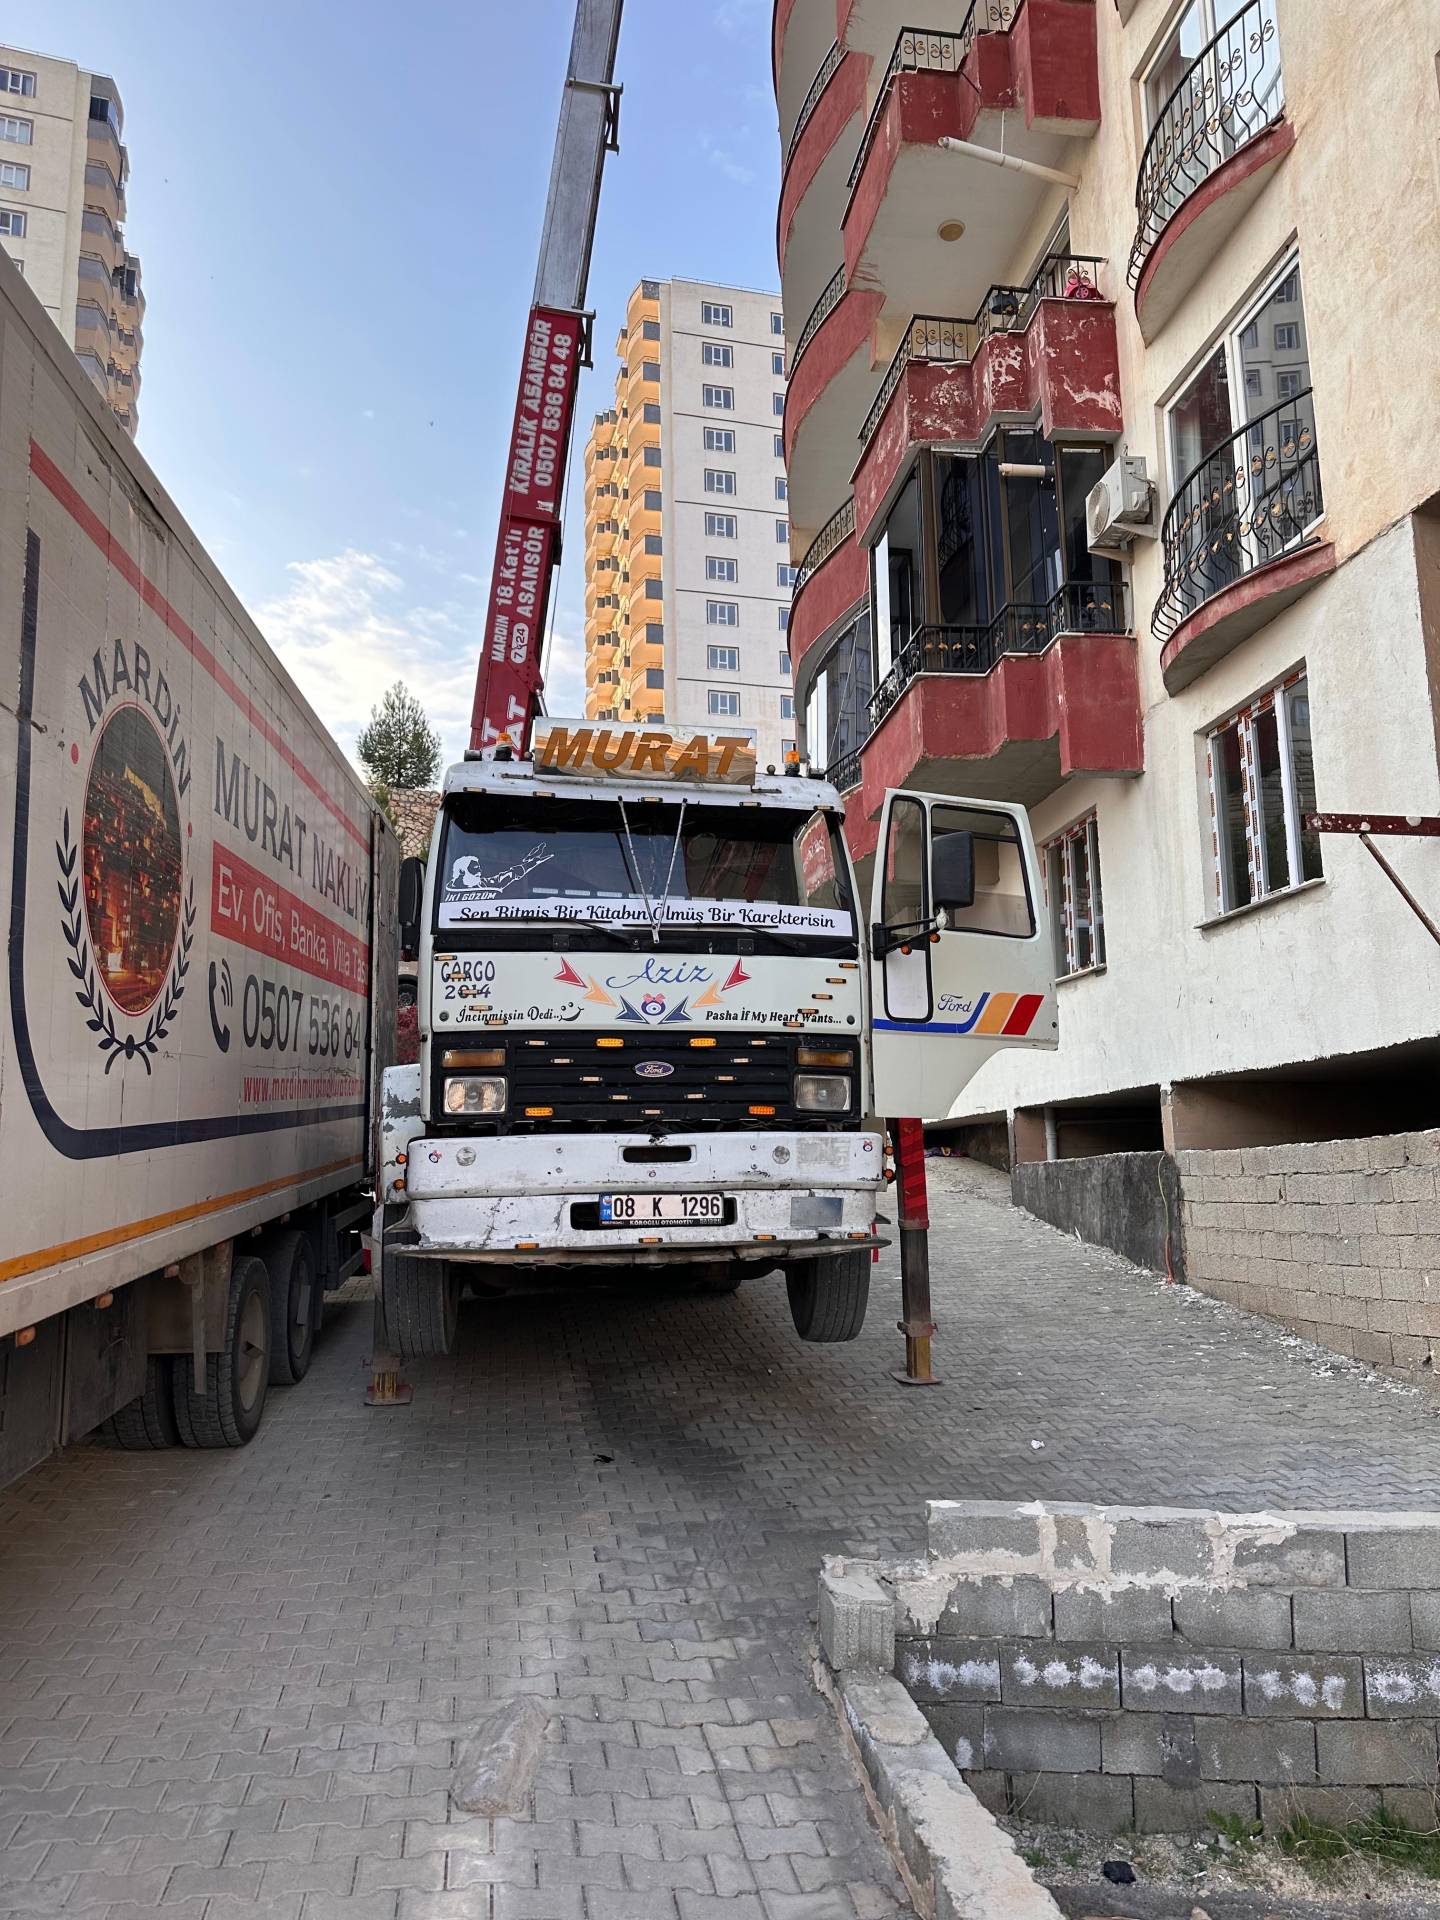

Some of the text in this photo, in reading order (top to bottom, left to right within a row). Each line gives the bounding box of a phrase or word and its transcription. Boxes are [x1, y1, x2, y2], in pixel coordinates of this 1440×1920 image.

[522, 319, 552, 413] ASANSÖR
[535, 334, 573, 487] 0507 536 84 48
[516, 526, 545, 618] ASANSÖR
[491, 615, 509, 662] MARDİN
[78, 638, 192, 798] MARDİN
[540, 726, 751, 776] MURAT
[214, 735, 369, 929] MURAT NAKLİY
[218, 863, 248, 932] Ev,
[252, 887, 287, 951] Ofis,
[290, 909, 330, 976] Banka,
[460, 907, 490, 919] Sen
[554, 905, 583, 919] Bir
[586, 904, 649, 920] Kitabın
[707, 907, 736, 922] Bir
[738, 908, 836, 928] Karekterisin
[605, 957, 714, 989] Aziz
[938, 993, 972, 1013] Ford
[242, 973, 361, 1059] 0507 536 84
[705, 1010, 738, 1021] Pasha
[751, 1011, 767, 1023] My
[769, 1011, 799, 1022] Heart
[801, 1013, 842, 1024] Wants...
[613, 1197, 635, 1218] 08
[652, 1197, 663, 1217] K
[681, 1196, 720, 1217] 1296
